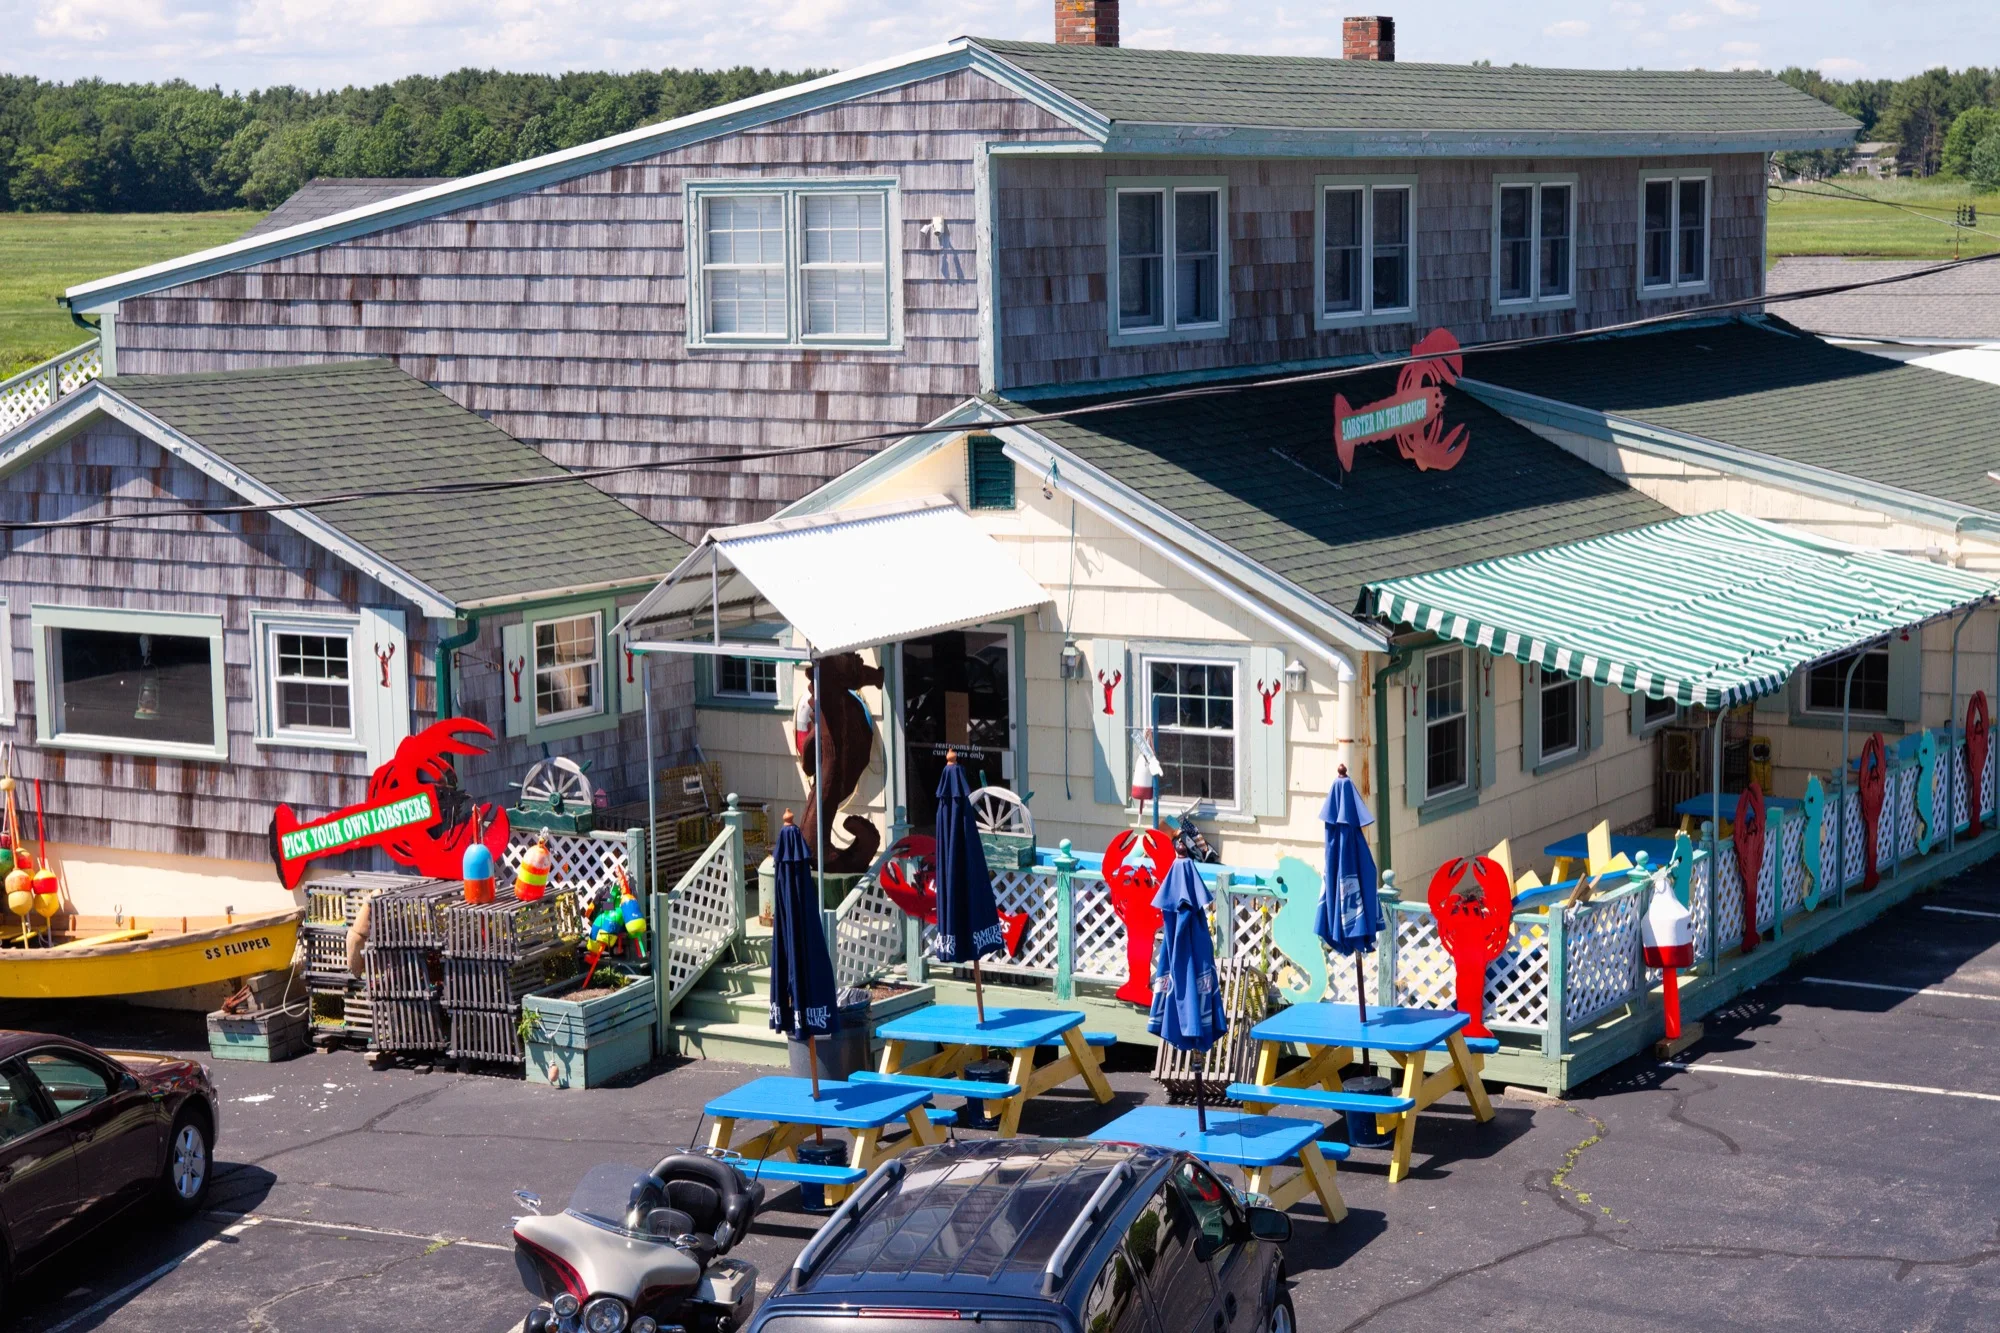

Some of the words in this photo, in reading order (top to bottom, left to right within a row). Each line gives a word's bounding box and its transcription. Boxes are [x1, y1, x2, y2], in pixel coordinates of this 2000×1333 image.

[1342, 413, 1375, 440] LOBSTER
[1376, 410, 1385, 431] IN
[1386, 406, 1401, 429] THE
[1402, 398, 1427, 425] ROUGH
[932, 750, 968, 758] custers
[970, 752, 984, 761] only
[935, 743, 970, 751] restrooms
[281, 830, 311, 858] PICK
[309, 821, 343, 850] YOUR
[343, 812, 372, 840] OWN
[370, 795, 432, 832] LOBSTERS
[224, 937, 271, 956] FLIPPER
